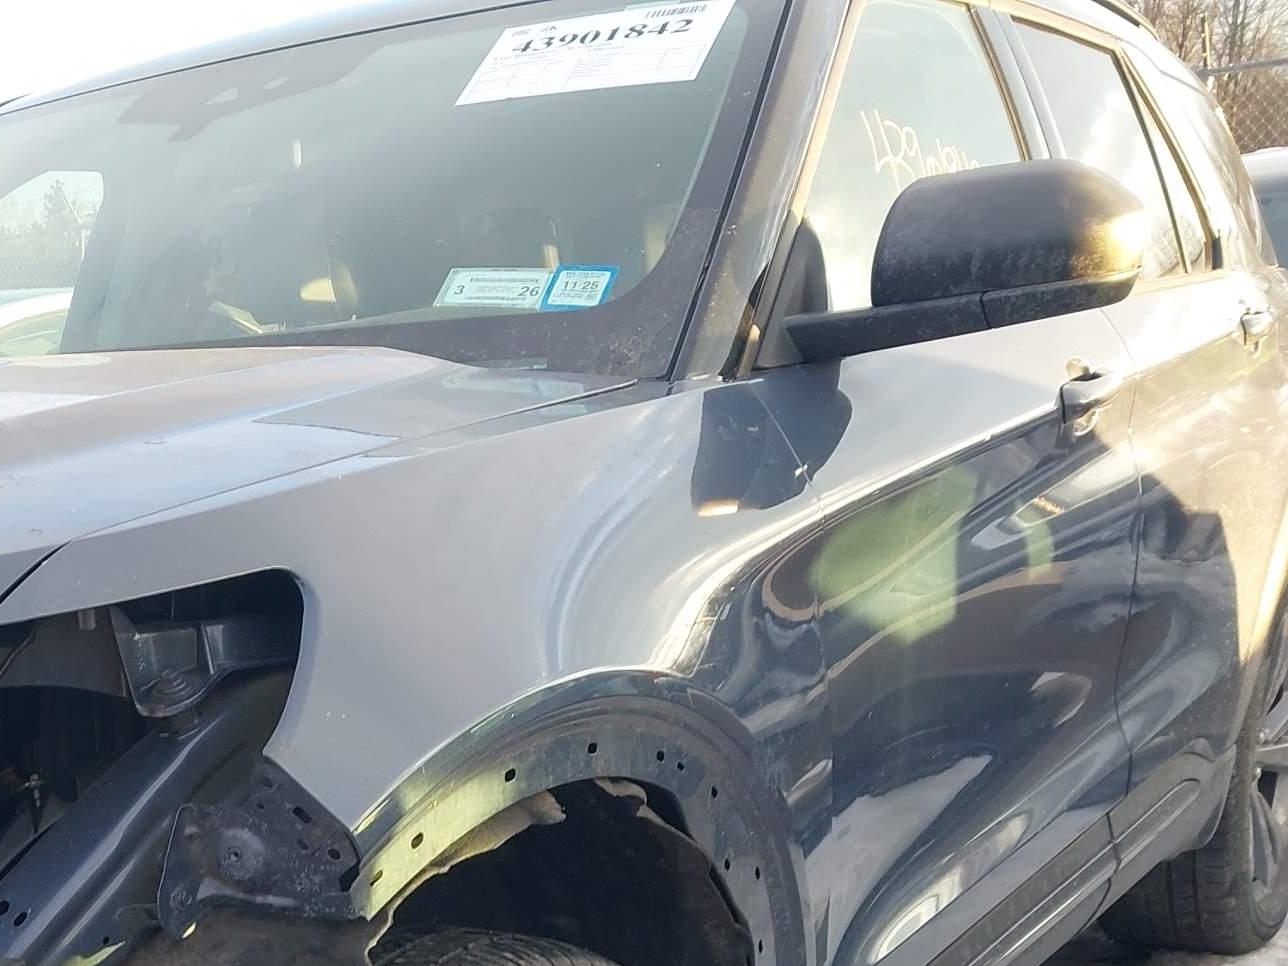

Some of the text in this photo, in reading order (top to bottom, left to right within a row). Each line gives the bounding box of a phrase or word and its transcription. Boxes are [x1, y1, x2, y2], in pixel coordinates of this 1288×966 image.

[512, 19, 694, 53] 43901842
[564, 280, 600, 289] 11 25
[454, 285, 540, 297] 3 26
